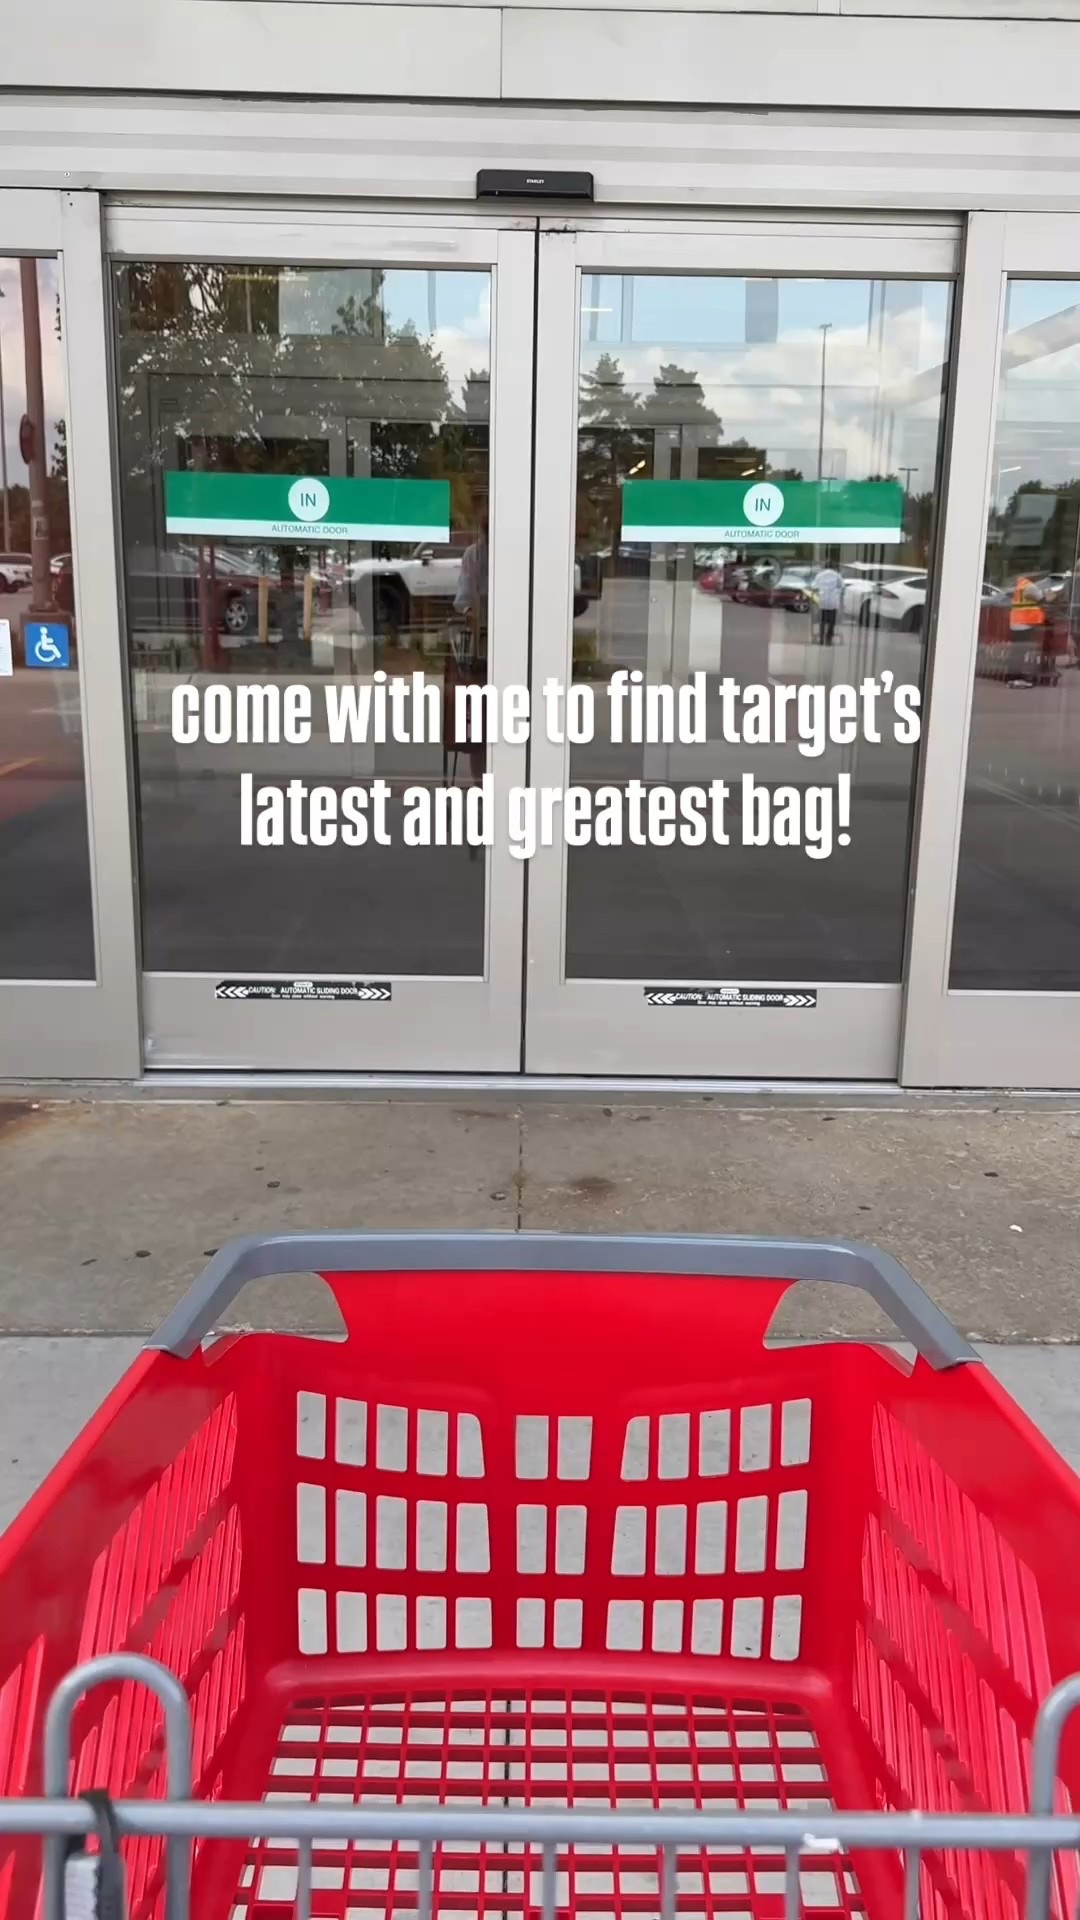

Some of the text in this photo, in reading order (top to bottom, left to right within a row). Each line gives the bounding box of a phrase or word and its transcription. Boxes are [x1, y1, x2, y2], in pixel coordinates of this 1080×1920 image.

[300, 493, 317, 507] IN
[755, 498, 771, 512] IN
[271, 524, 348, 535] AUTOMATIC DOOR
[724, 530, 800, 539] AUTOMATIC DOOR
[280, 986, 316, 995] AUTOMATIC
[317, 987, 340, 995] SLIDING
[340, 987, 358, 995] DOOR
[707, 993, 742, 1001] AUTOMATIC
